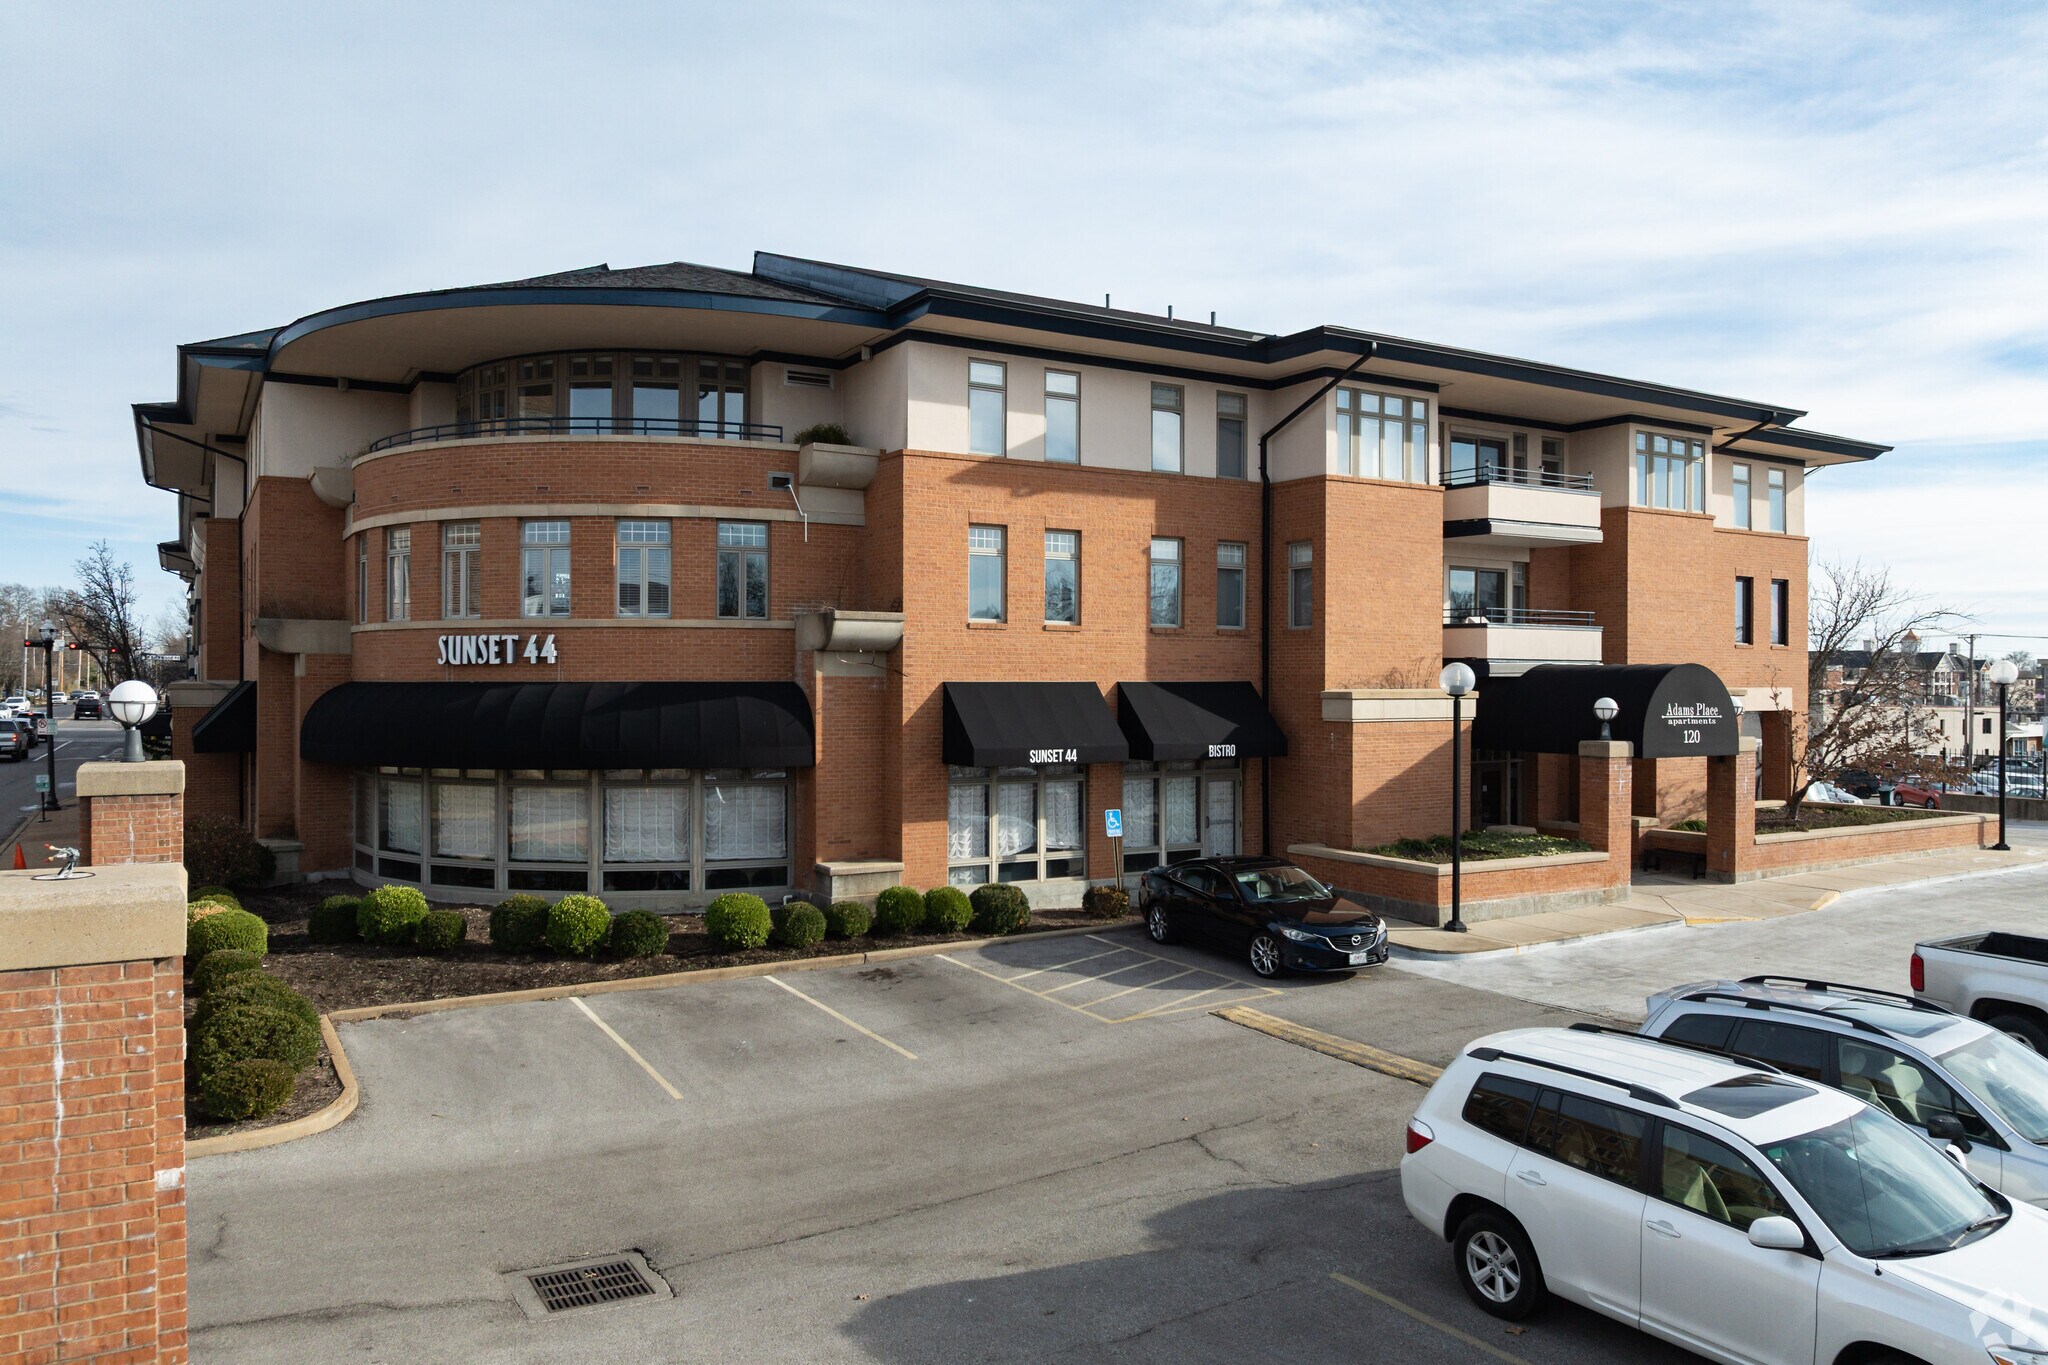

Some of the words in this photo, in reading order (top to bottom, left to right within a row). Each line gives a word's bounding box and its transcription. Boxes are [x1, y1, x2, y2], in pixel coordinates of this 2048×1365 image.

[438, 634, 519, 665] SUNSET
[523, 634, 557, 664] 44
[1666, 703, 1694, 716] Adams
[1696, 703, 1719, 716] Place
[1667, 718, 1717, 726] apartments
[1683, 729, 1701, 744] 120
[1029, 749, 1064, 763] SUNSET
[1065, 748, 1078, 762] 44
[1208, 744, 1236, 757] BISTRO
